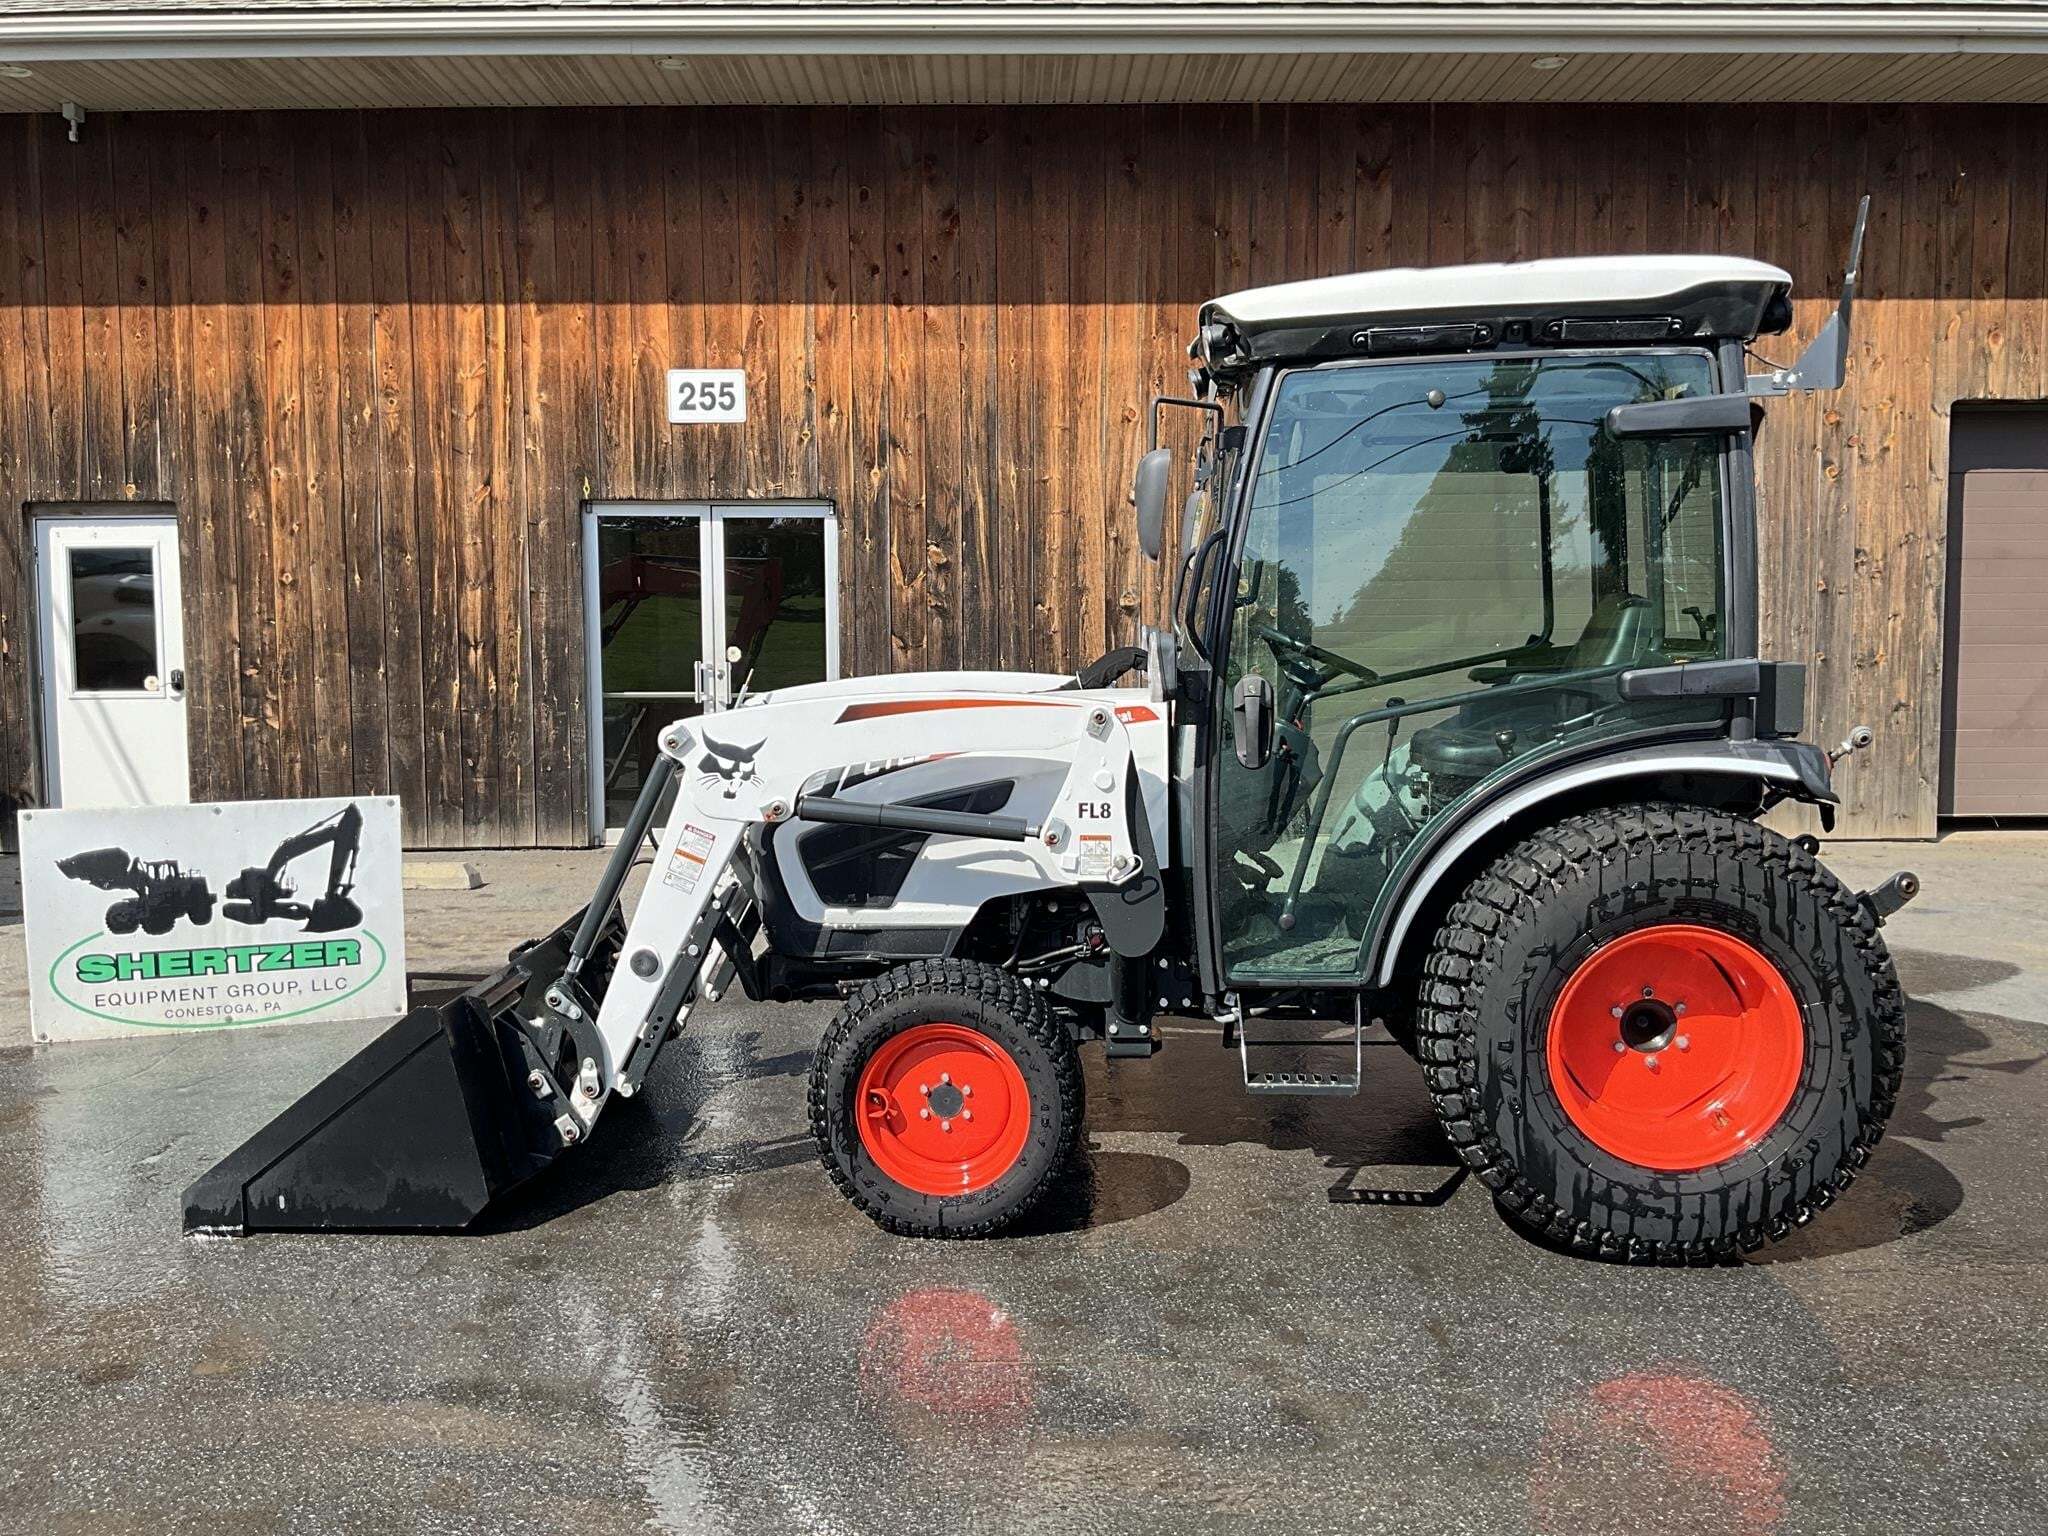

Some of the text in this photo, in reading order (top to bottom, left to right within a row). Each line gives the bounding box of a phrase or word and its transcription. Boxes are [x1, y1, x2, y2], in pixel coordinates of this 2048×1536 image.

[679, 382, 736, 411] 255
[1078, 802, 1112, 819] FL8
[77, 939, 361, 983] SHERTZER
[94, 976, 348, 1008] EQUIPMENT GROUP, LLC
[164, 1001, 282, 1019] CONESTOGA, PA
